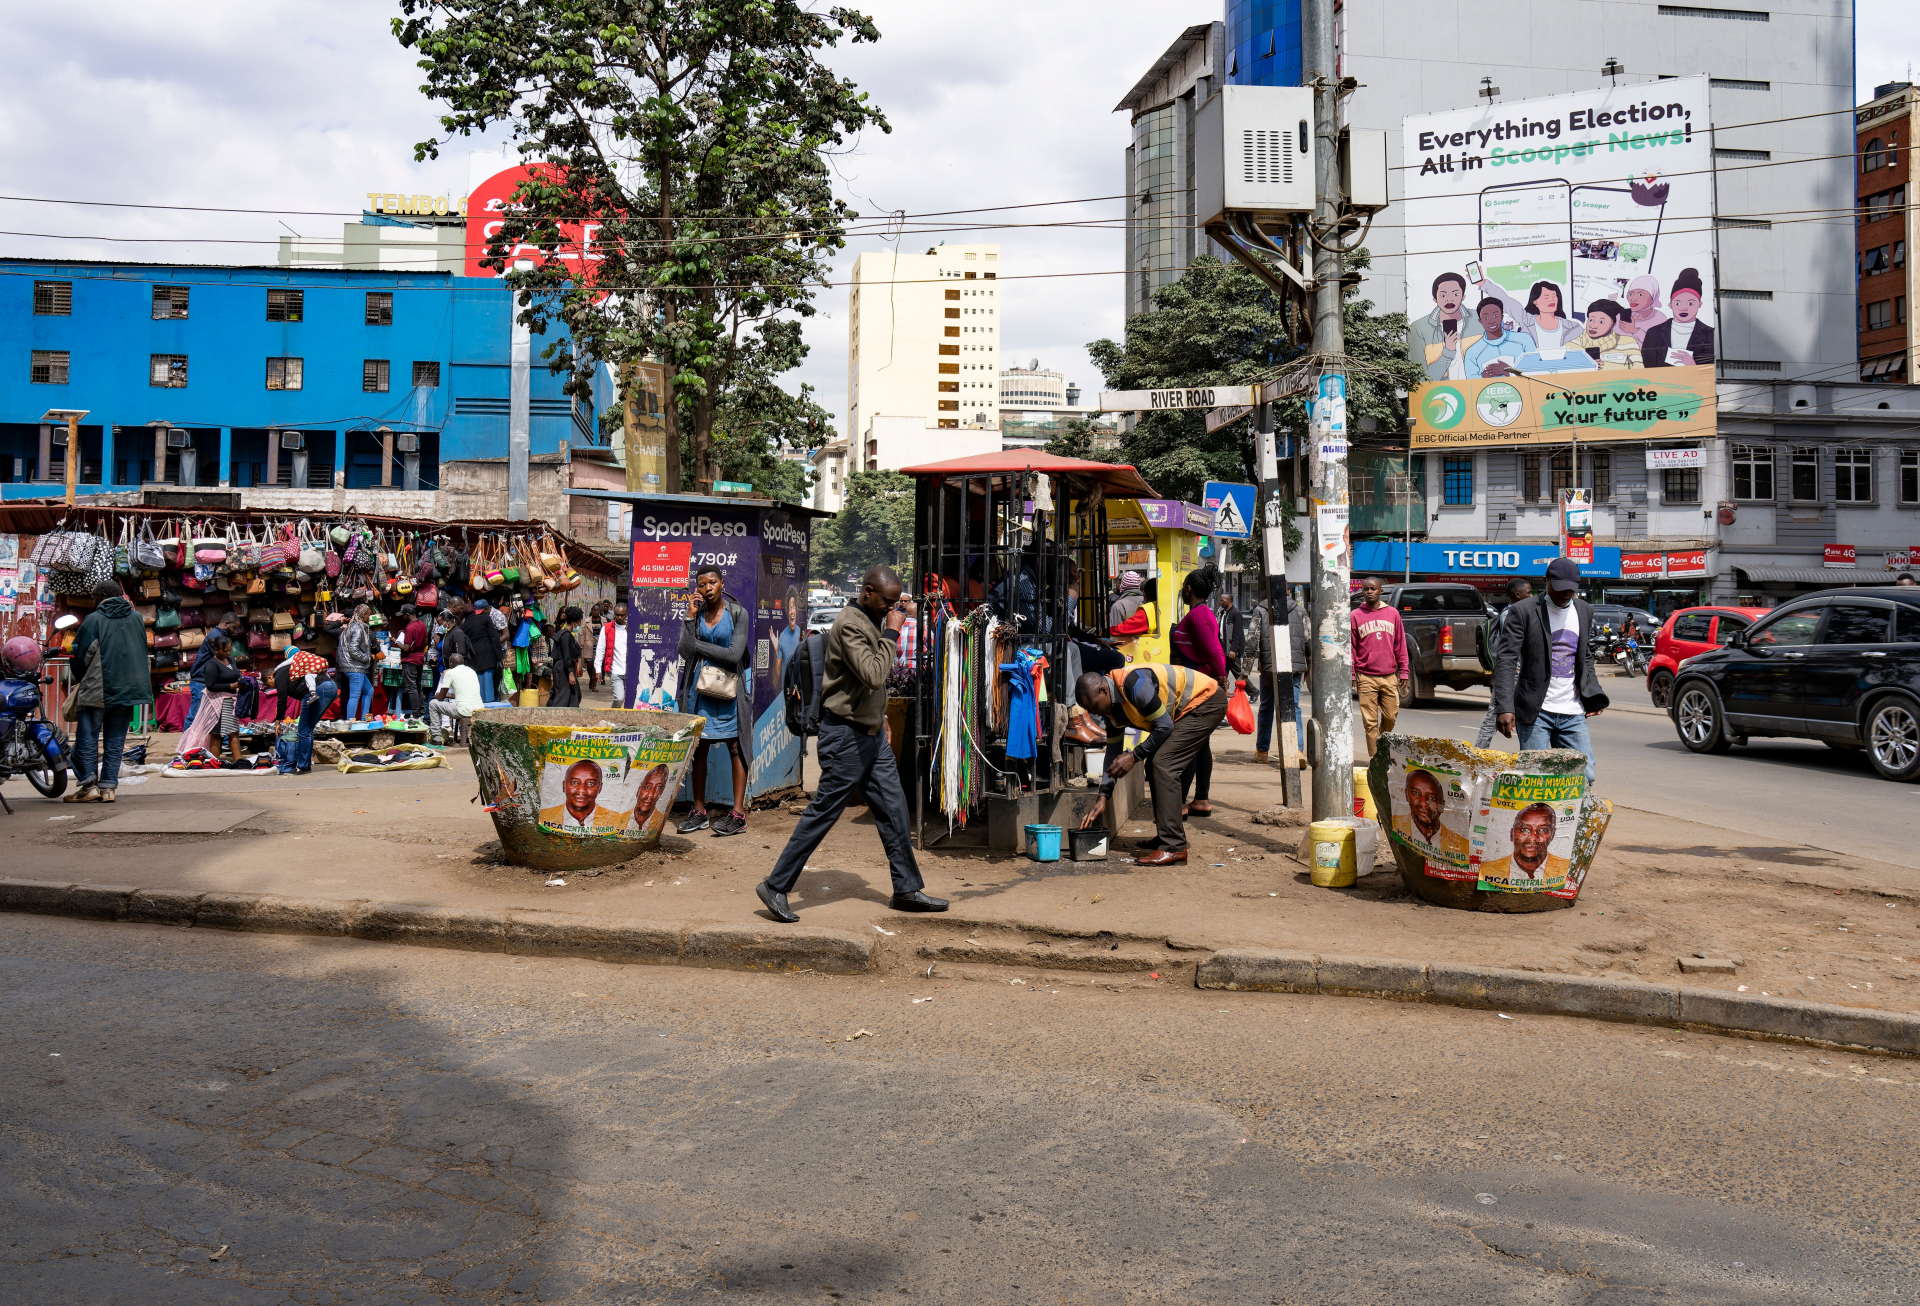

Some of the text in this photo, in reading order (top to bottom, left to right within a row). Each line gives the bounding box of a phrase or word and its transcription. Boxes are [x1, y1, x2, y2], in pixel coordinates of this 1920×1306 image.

[1419, 101, 1691, 151] Everything Election,
[1420, 122, 1692, 177] All in Scooper News!
[367, 193, 449, 216] TEMBO
[1493, 198, 1520, 206] Scooper
[1581, 201, 1611, 210] Scooper
[1623, 244, 1645, 252] IEBC
[1486, 386, 1512, 395] IEBC
[1612, 388, 1658, 403] vote
[1151, 389, 1215, 409] RIVER ROAD
[1553, 408, 1602, 426] Your
[632, 432, 665, 447] OFFICE
[1415, 431, 1532, 444] IEBC Official Media Partner
[633, 444, 666, 457] CHAIRS
[1322, 445, 1347, 454] AGNES
[1653, 450, 1698, 459] LIVE AD
[643, 516, 747, 542] SportPesa
[763, 519, 807, 546] SportPesa
[1443, 551, 1520, 568] TECNO
[1843, 549, 1856, 558] 4G
[1646, 558, 1662, 567] 4G
[1690, 556, 1705, 565] 4G
[1887, 556, 1909, 565] 1000
[665, 564, 684, 572] CARD
[670, 594, 693, 602] PLAY
[1376, 632, 1382, 640] C
[759, 716, 775, 750] TAKE
[568, 739, 588, 747] JOHN
[642, 738, 655, 749] HON
[552, 744, 624, 758] KWENYA
[640, 749, 686, 763] KWENYA
[550, 756, 567, 764] VOTE
[1497, 775, 1584, 788] HON JOHN MWANIKI
[1447, 790, 1465, 799] UDA
[1499, 784, 1580, 800] KWENYA
[1496, 800, 1516, 808] VOTE
[1560, 815, 1575, 823] UDA
[543, 820, 615, 834] MCA CENTRAL WARD
[1397, 827, 1466, 862] MCA CENTRAL WARD
[1484, 875, 1565, 887] MCA CENTRAL WARD
